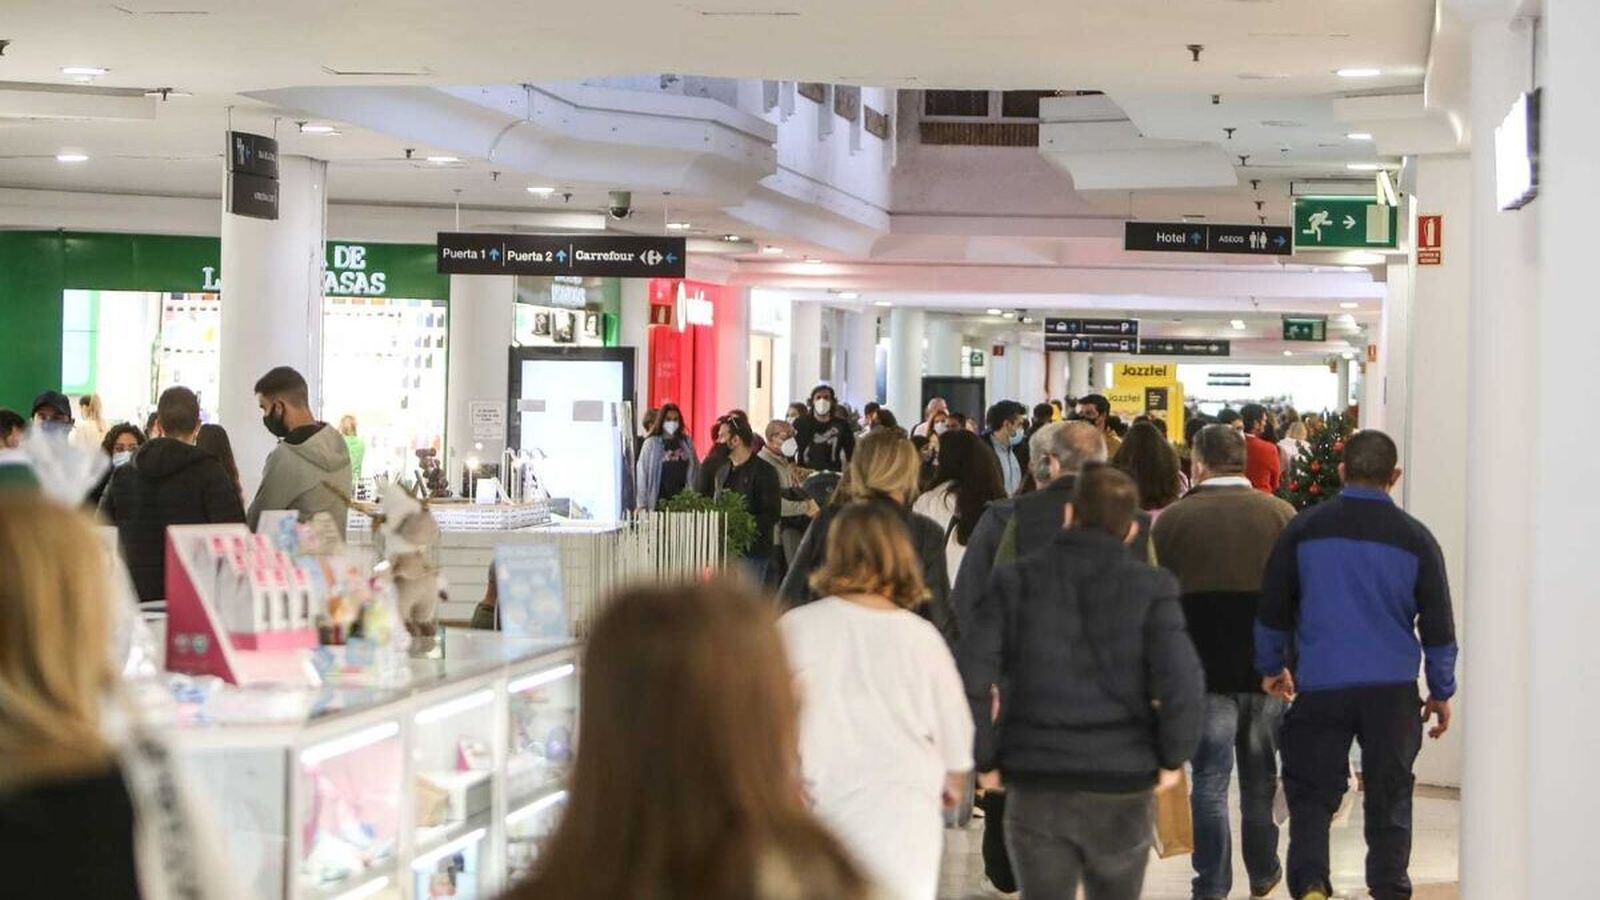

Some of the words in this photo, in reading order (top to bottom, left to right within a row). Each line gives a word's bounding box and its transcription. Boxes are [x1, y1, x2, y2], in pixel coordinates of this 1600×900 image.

[1156, 231, 1186, 243] Hotel
[1218, 235, 1244, 244] ASEOS
[334, 245, 367, 270] DE
[442, 248, 478, 259] Puerta
[480, 249, 486, 259] 1
[507, 250, 543, 261] Puerta
[545, 251, 553, 262] 2
[575, 250, 634, 261] Carrefour
[324, 270, 386, 295] ASAS
[1121, 364, 1167, 377] Jazztel
